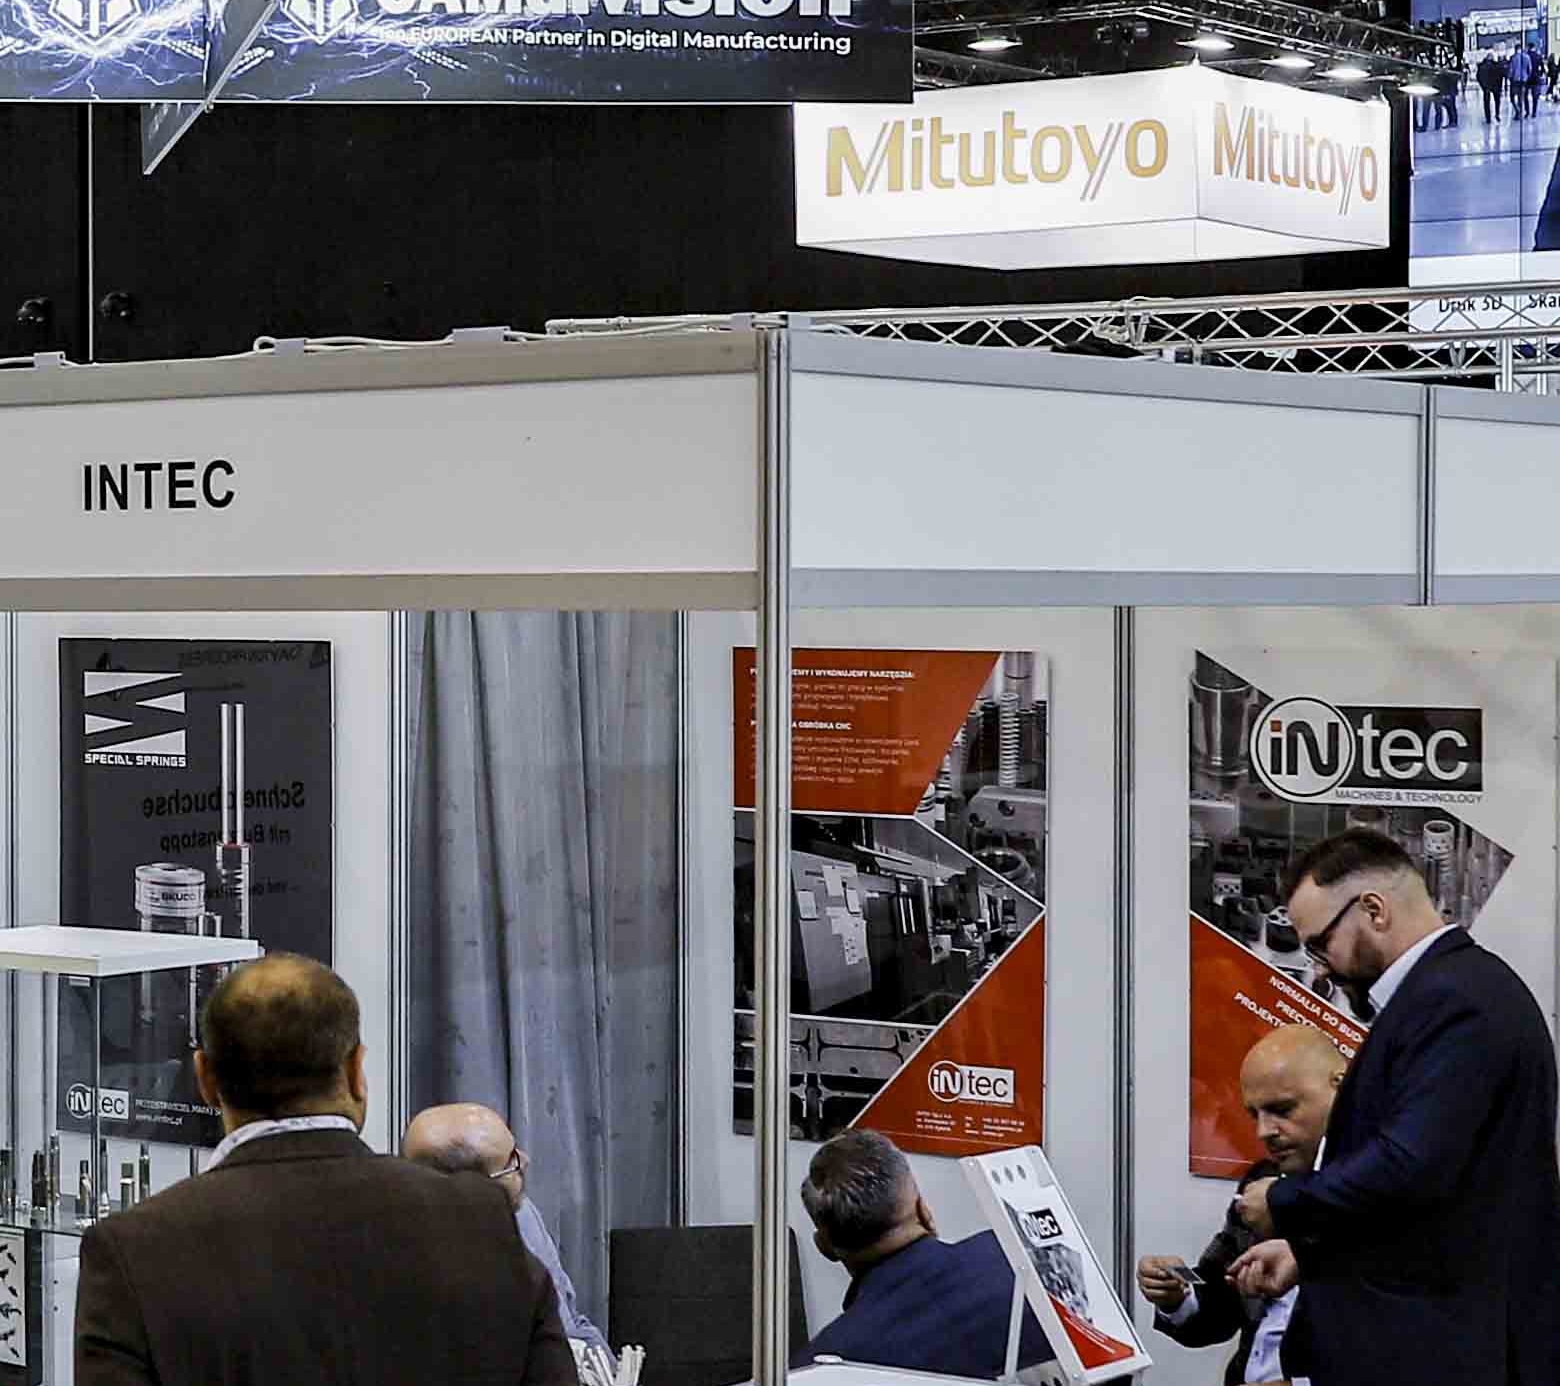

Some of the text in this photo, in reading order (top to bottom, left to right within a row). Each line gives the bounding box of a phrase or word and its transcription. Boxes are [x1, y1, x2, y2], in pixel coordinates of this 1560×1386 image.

[410, 26, 508, 45] EUROPEAN
[512, 27, 584, 46] Partner
[586, 28, 606, 47] in
[610, 29, 678, 53] Digital
[683, 30, 852, 55] Manufacturing
[824, 111, 1170, 202] Mitutoyo
[1214, 101, 1379, 216] Mitutoyo
[82, 459, 237, 512] INTEC
[84, 753, 187, 768] SPECIAL SPRINGS
[1334, 788, 1395, 802] MACHINES
[1405, 790, 1482, 804] TECHNOLOGY
